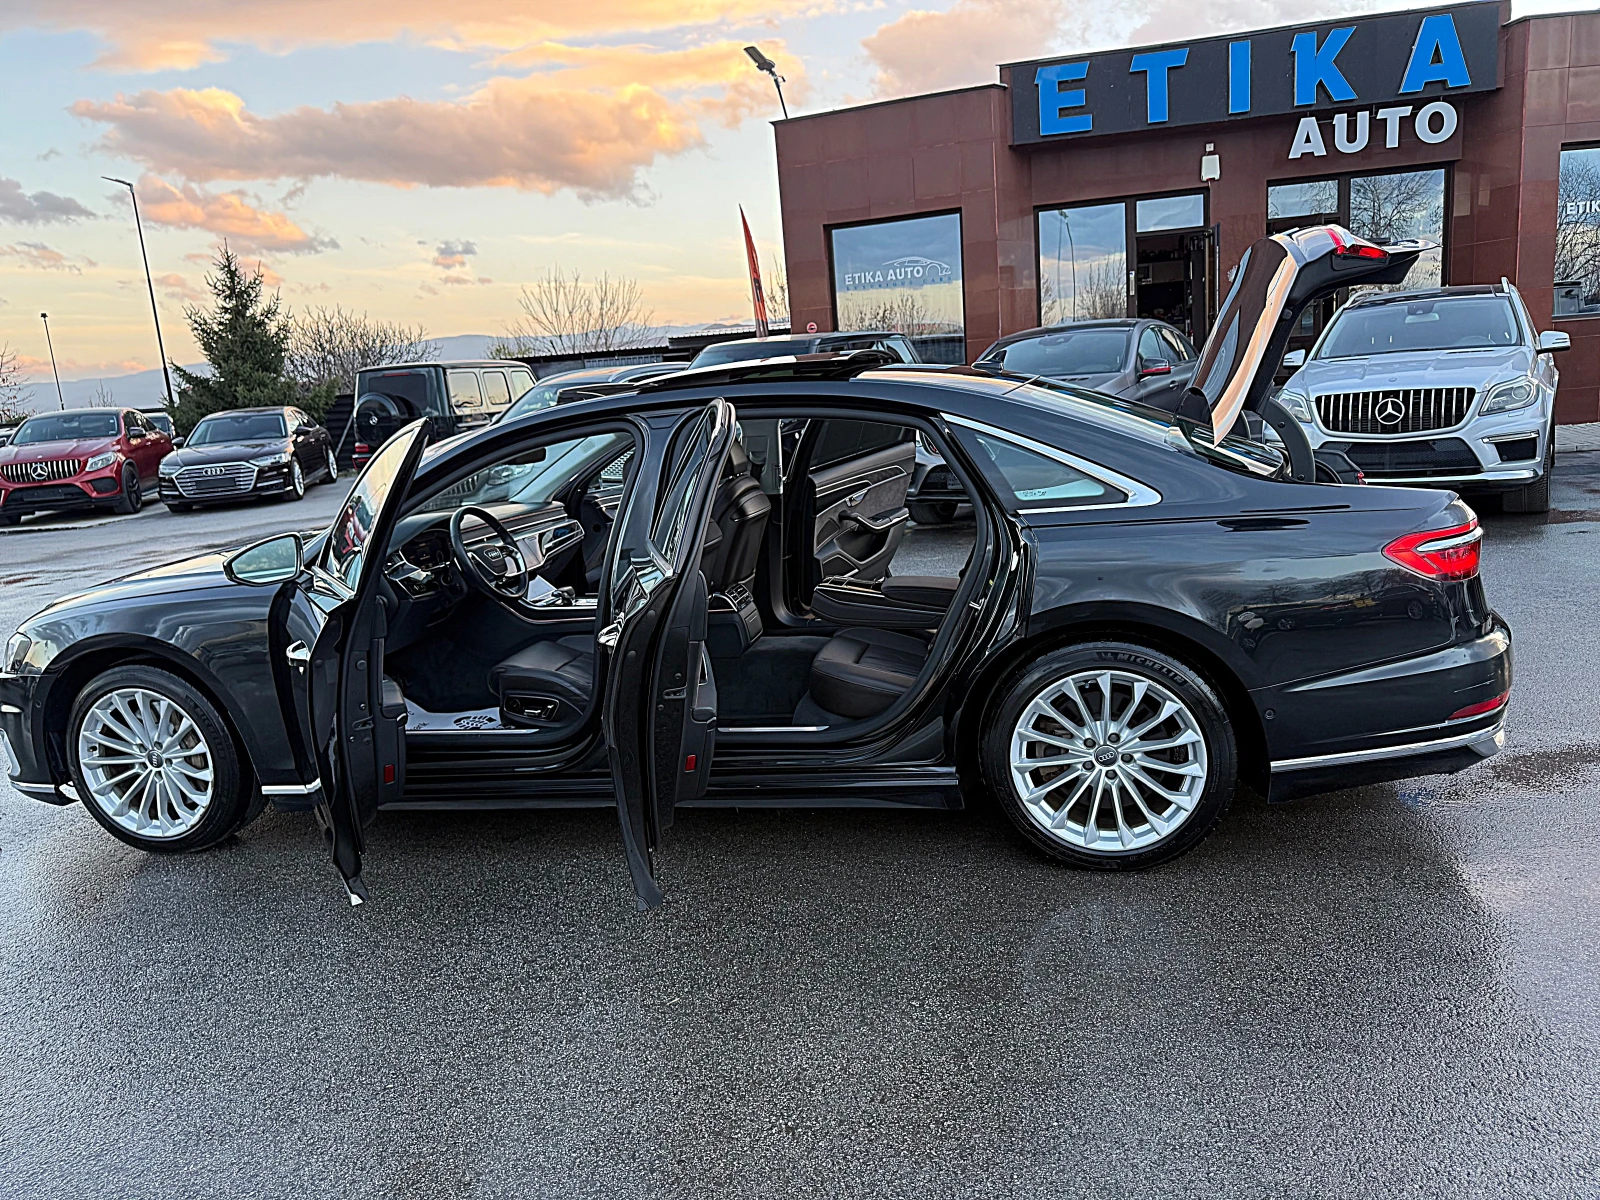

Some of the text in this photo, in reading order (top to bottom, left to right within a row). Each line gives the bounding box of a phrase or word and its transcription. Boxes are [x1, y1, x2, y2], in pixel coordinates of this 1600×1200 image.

[1034, 13, 1471, 136] ETIKA
[1288, 101, 1458, 159] AUTO
[844, 266, 924, 286] ETIKA AUTO
[1117, 653, 1185, 684] MICHELIN
